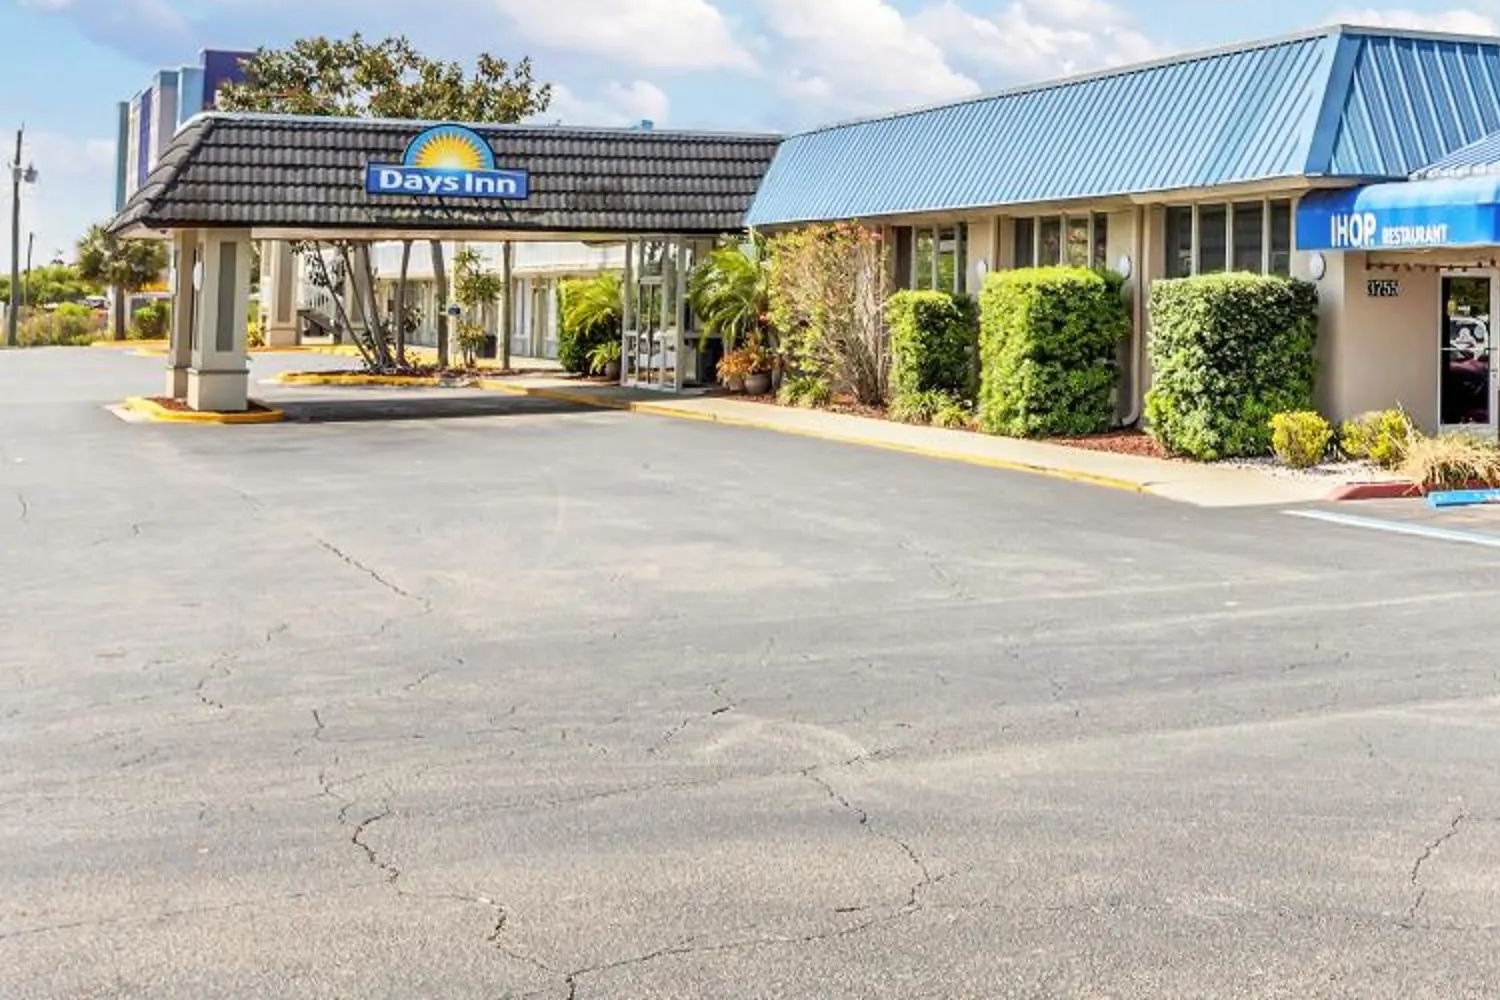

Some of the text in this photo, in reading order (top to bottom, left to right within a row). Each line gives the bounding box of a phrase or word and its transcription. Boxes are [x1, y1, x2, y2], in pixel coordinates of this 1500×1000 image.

[379, 169, 517, 193] Days Inn
[1381, 224, 1448, 245] RESTAURANT
